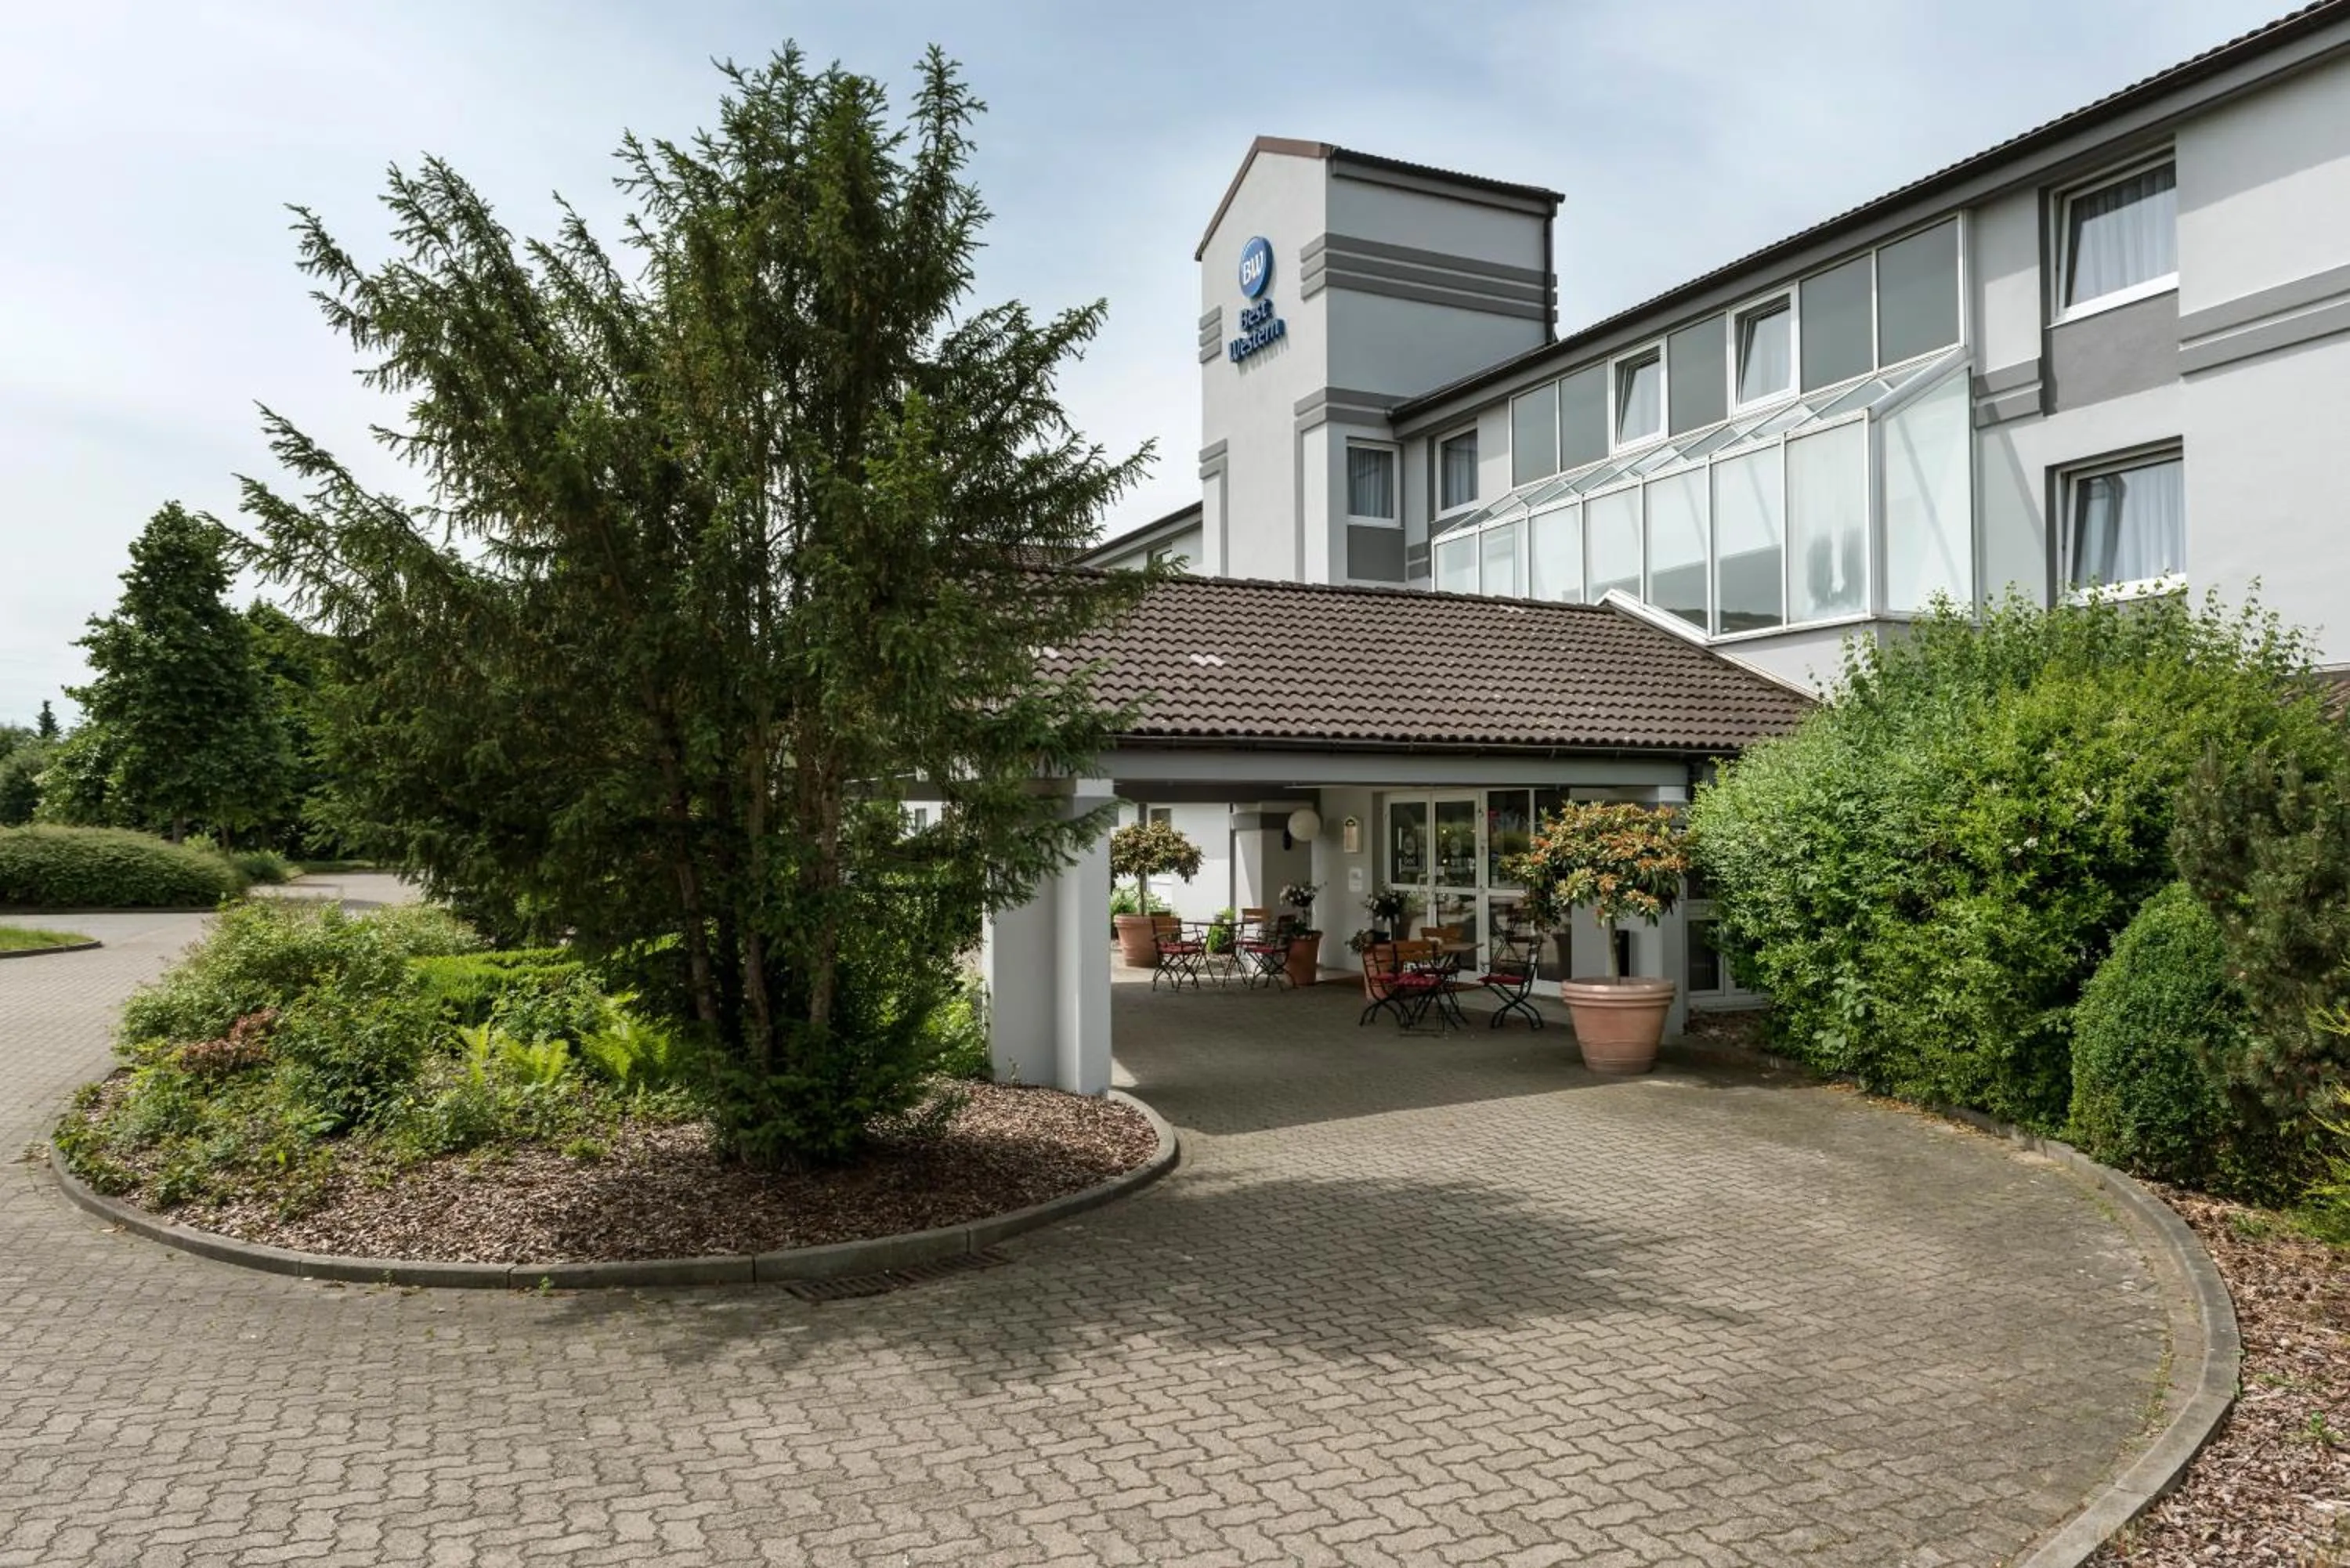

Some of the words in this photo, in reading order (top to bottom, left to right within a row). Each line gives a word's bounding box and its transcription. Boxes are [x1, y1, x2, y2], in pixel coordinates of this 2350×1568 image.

[1242, 251, 1264, 285] BW
[1241, 299, 1273, 331] Best
[1228, 318, 1285, 363] Western
